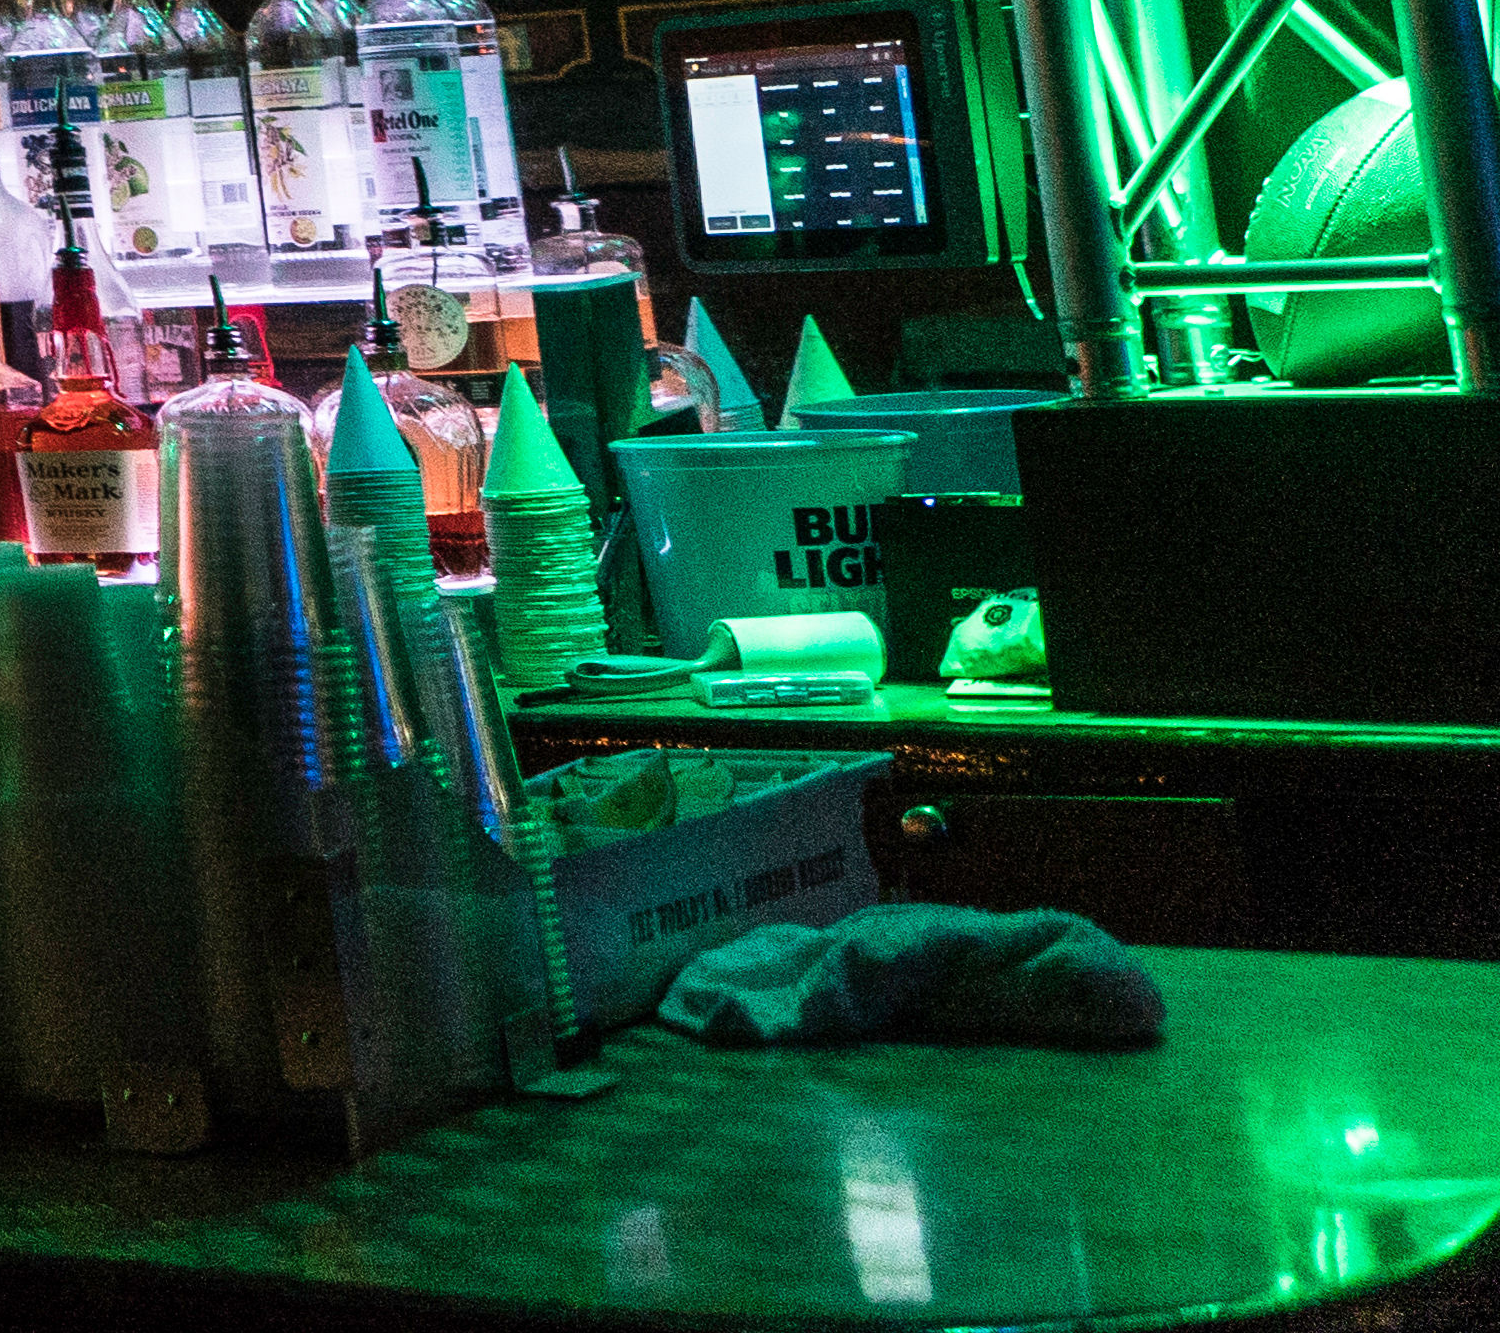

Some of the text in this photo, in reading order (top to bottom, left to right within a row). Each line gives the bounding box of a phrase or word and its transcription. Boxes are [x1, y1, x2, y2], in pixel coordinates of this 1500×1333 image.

[408, 110, 440, 129] One
[25, 461, 121, 479] Maker's
[53, 484, 123, 501] Mark
[773, 546, 885, 590] LIGH
